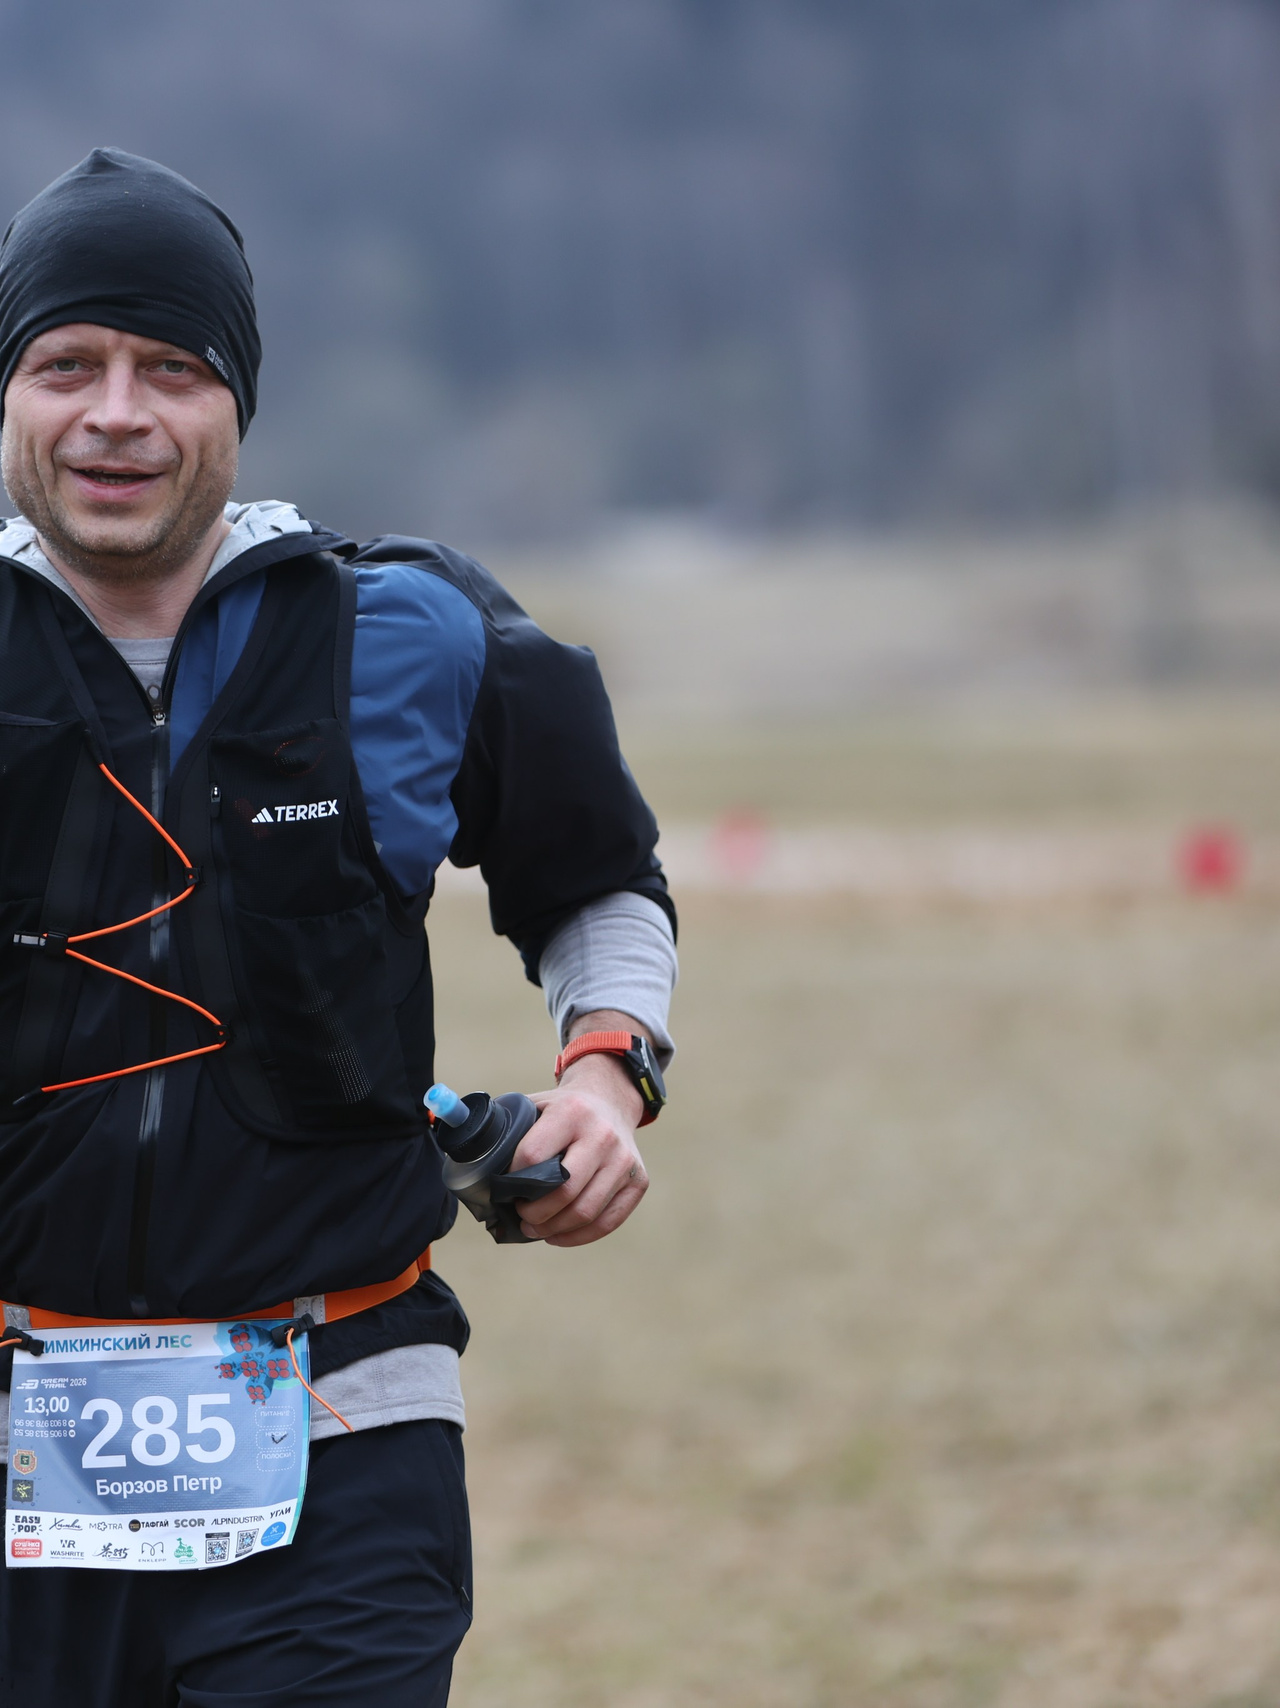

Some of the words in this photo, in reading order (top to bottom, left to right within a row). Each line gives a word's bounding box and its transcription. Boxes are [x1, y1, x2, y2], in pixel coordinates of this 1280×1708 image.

[274, 799, 339, 822] TERREX
[43, 1333, 150, 1354] ИМКИНСКИЙ
[156, 1334, 192, 1348] ЛЕС
[70, 1378, 87, 1386] 2026
[24, 1396, 70, 1416] 13,00
[80, 1393, 236, 1469] 285
[96, 1478, 168, 1499] Борзов
[173, 1474, 222, 1494] Петр
[14, 1515, 41, 1524] EASY
[141, 1519, 169, 1528] ТАФГАЙ
[174, 1518, 206, 1528] SCOR
[210, 1515, 265, 1526] ALPINDUSTRIA
[18, 1525, 37, 1533] POP
